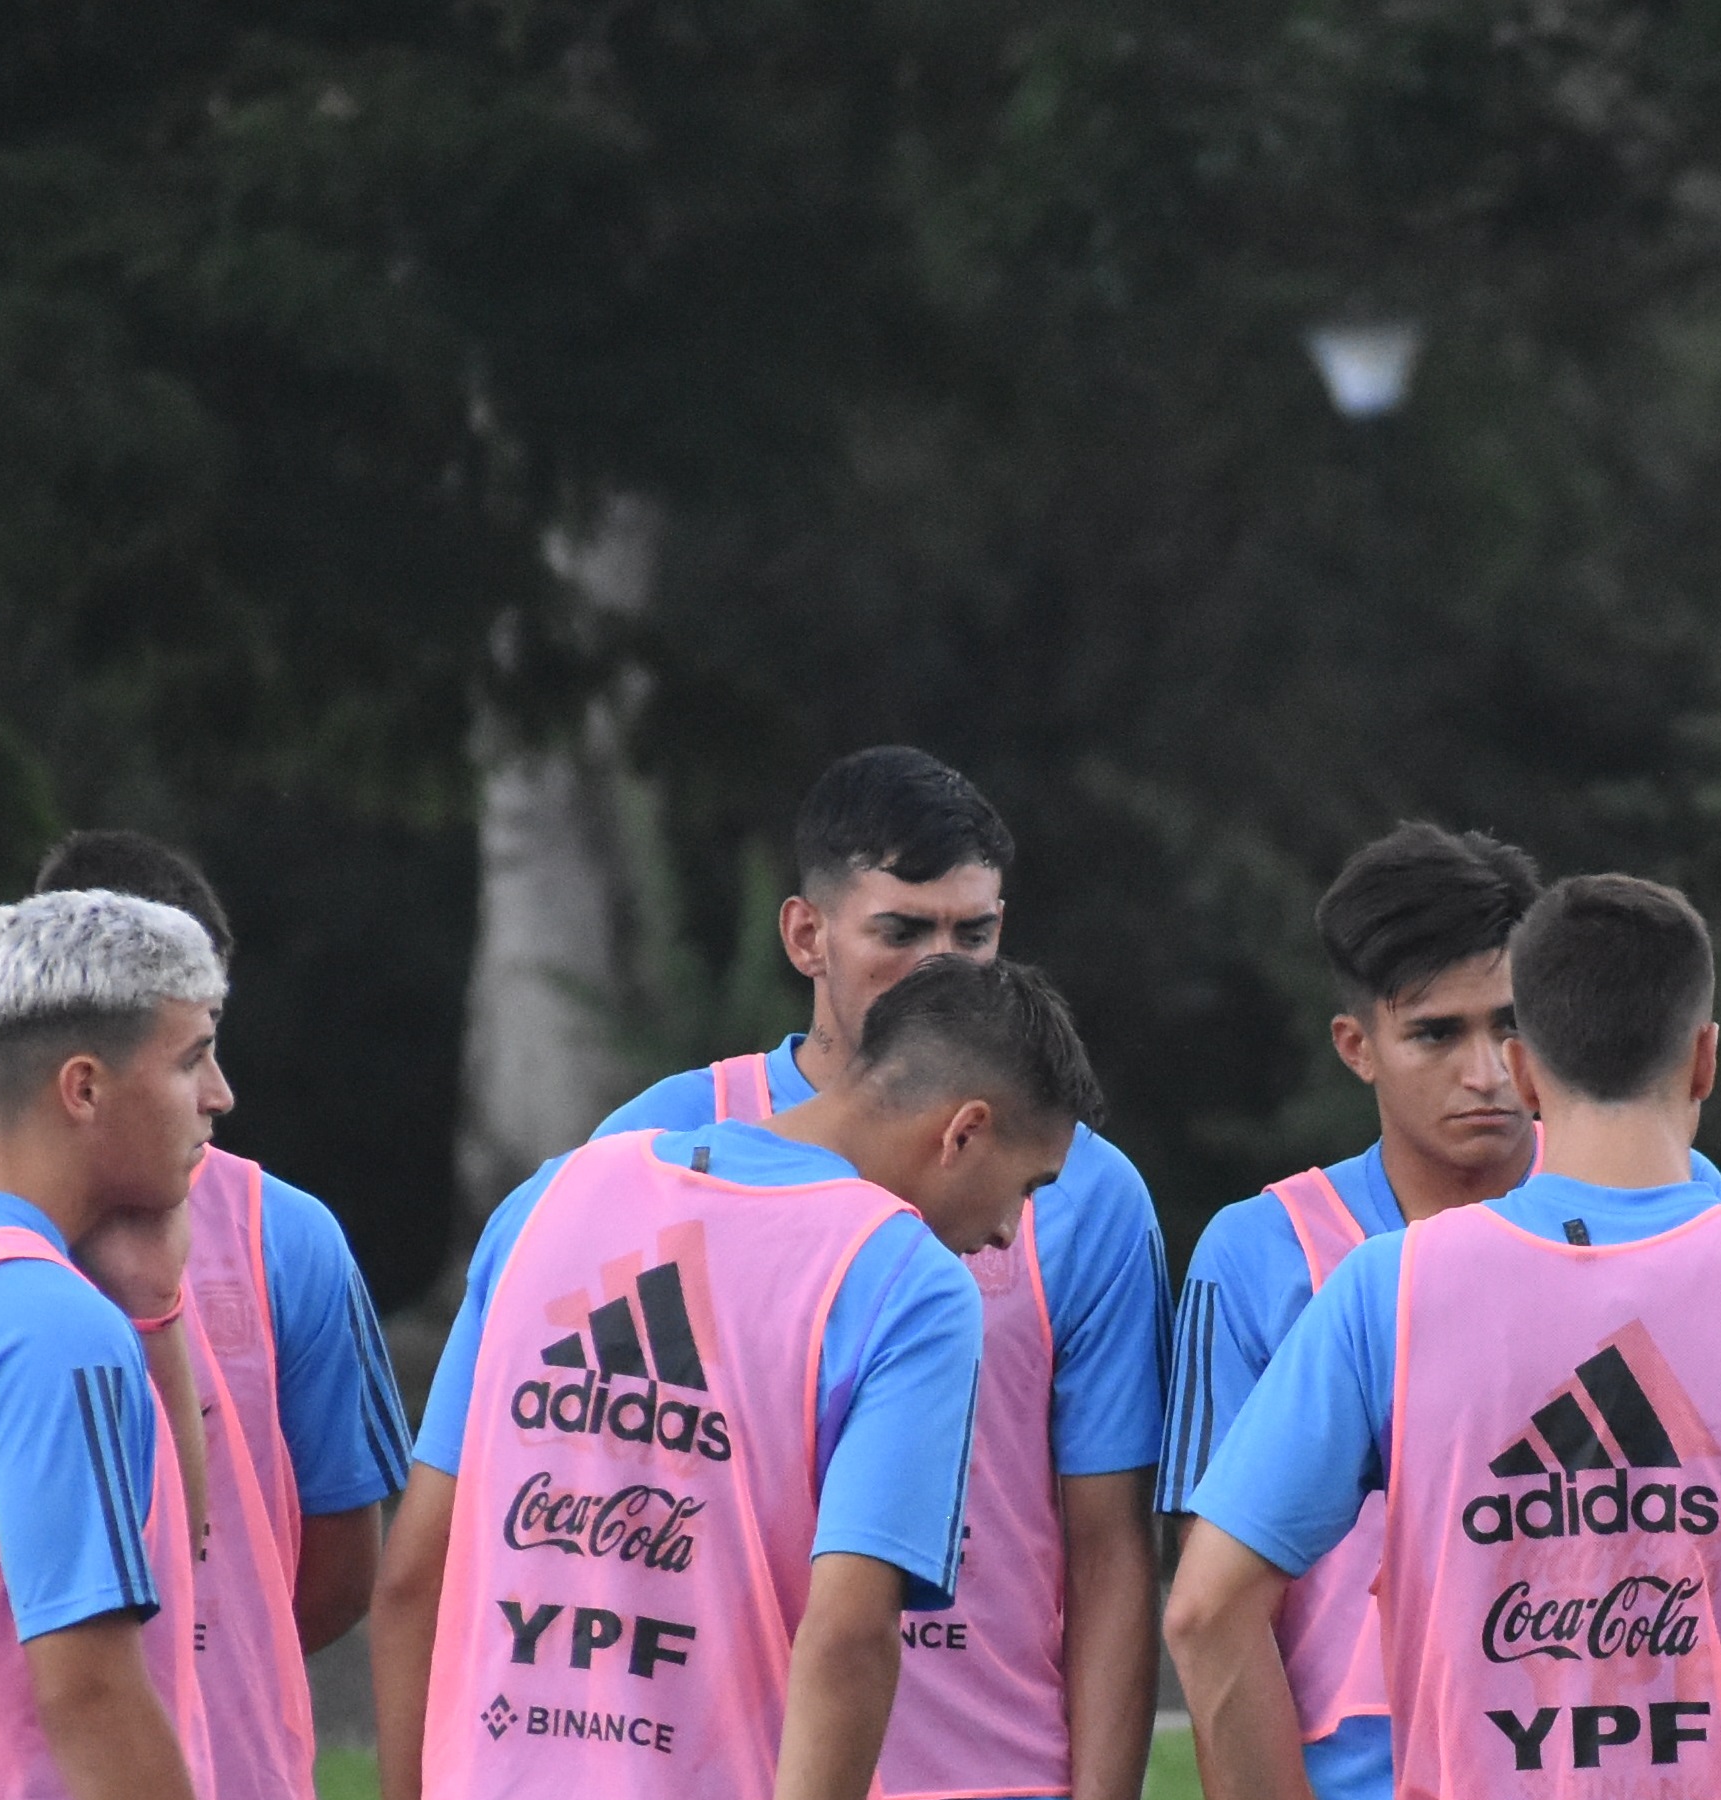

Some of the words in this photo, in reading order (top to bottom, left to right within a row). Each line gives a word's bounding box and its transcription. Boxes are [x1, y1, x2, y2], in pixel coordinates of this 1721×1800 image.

[511, 1369, 732, 1461] adidas
[503, 1471, 706, 1573] Coca-Cola
[1462, 1469, 1720, 1545] adidas
[498, 1600, 696, 1679] YPF
[1482, 1576, 1705, 1663] Coca-Cola
[527, 1707, 674, 1754] BINANCE
[1484, 1702, 1711, 1771] YPF
